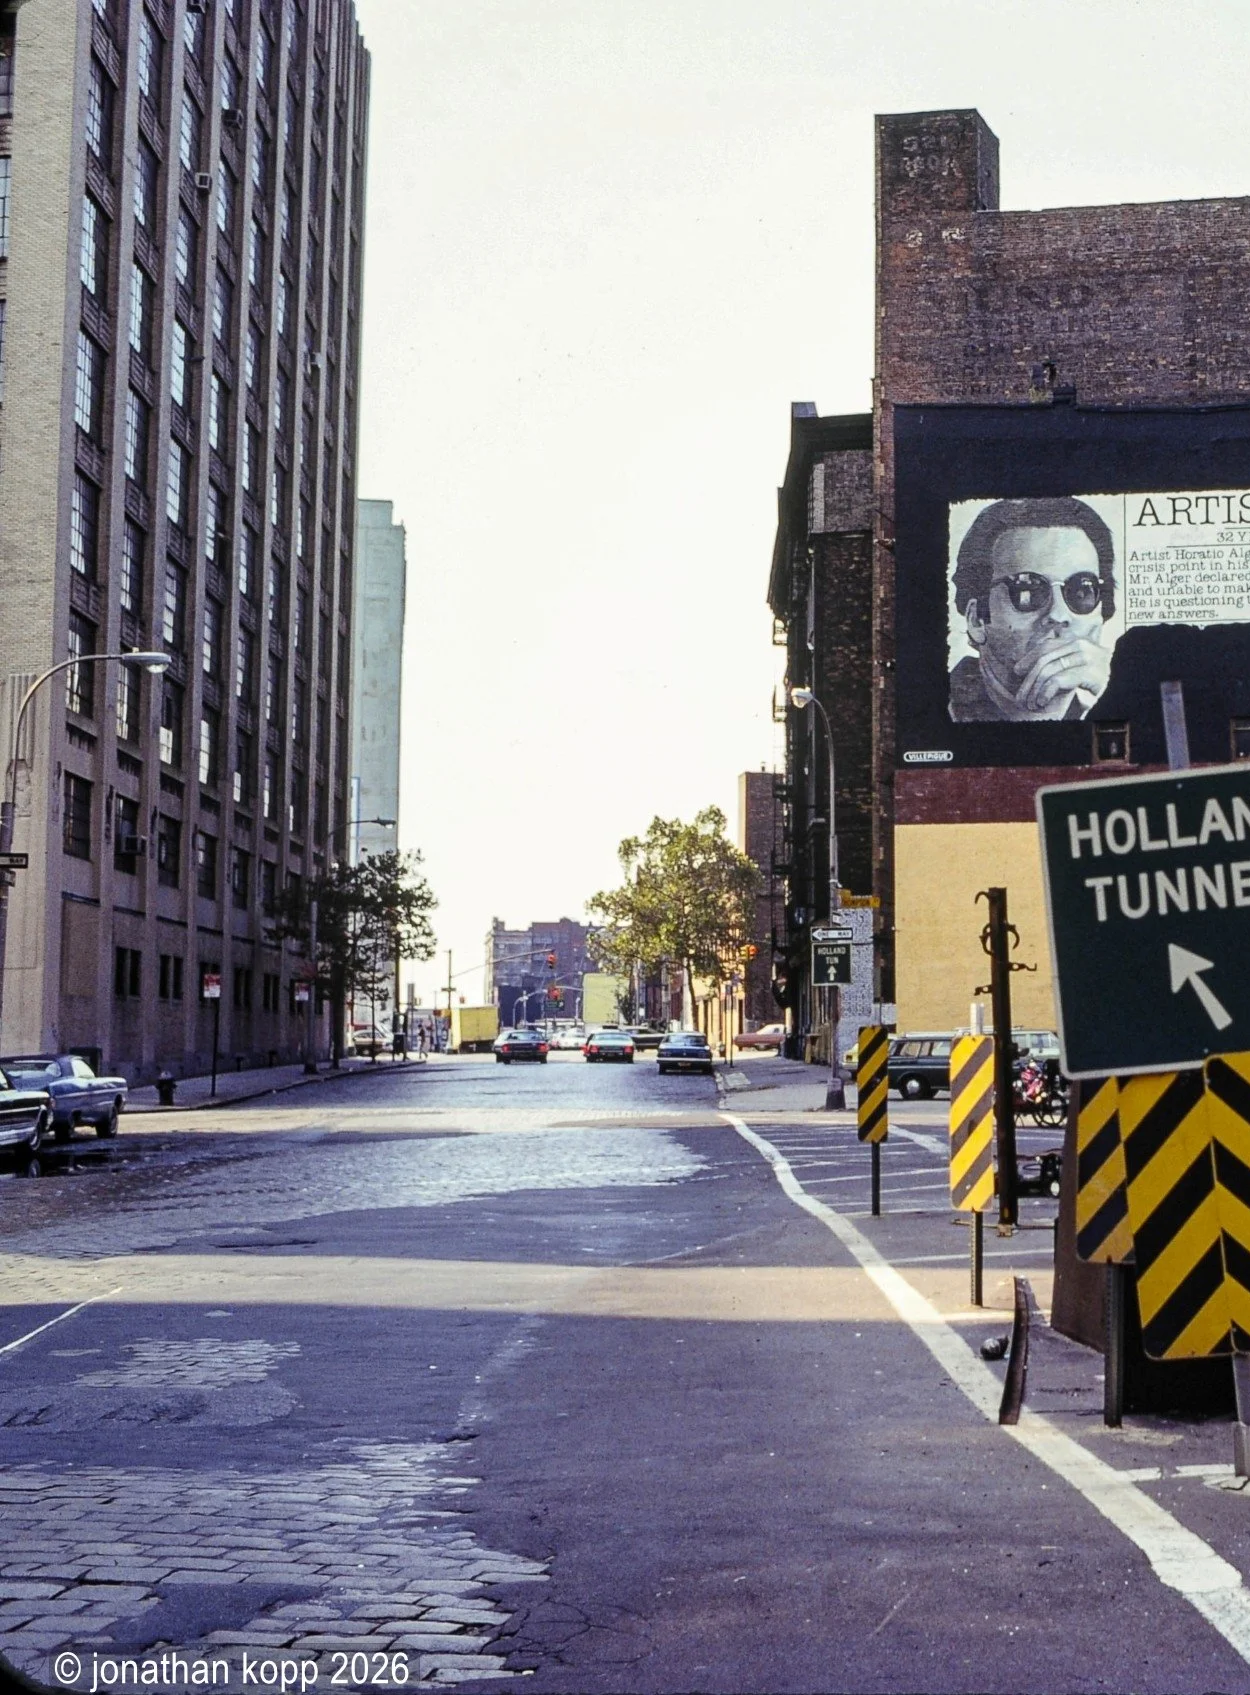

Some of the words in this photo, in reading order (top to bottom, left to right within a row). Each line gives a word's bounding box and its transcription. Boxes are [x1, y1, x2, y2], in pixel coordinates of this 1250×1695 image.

[1217, 531, 1234, 543] 32
[1129, 549, 1170, 562] Artist
[1175, 548, 1224, 560] Horatio
[1128, 562, 1165, 573] crisis
[1170, 560, 1206, 574] point
[1210, 560, 1223, 571] in
[1227, 559, 1248, 570] his
[1129, 573, 1150, 585] Mr.
[1154, 572, 1191, 587] Alger
[1128, 585, 1153, 597] and
[1157, 584, 1204, 597] unable
[1207, 584, 1220, 595] to
[1129, 597, 1147, 608] He
[1149, 596, 1161, 608] is
[1163, 594, 1244, 609] questioning
[1128, 610, 1154, 620] new
[1158, 608, 1219, 619] answers.
[817, 946, 847, 955] HOLLAND
[826, 956, 839, 965] TUN
